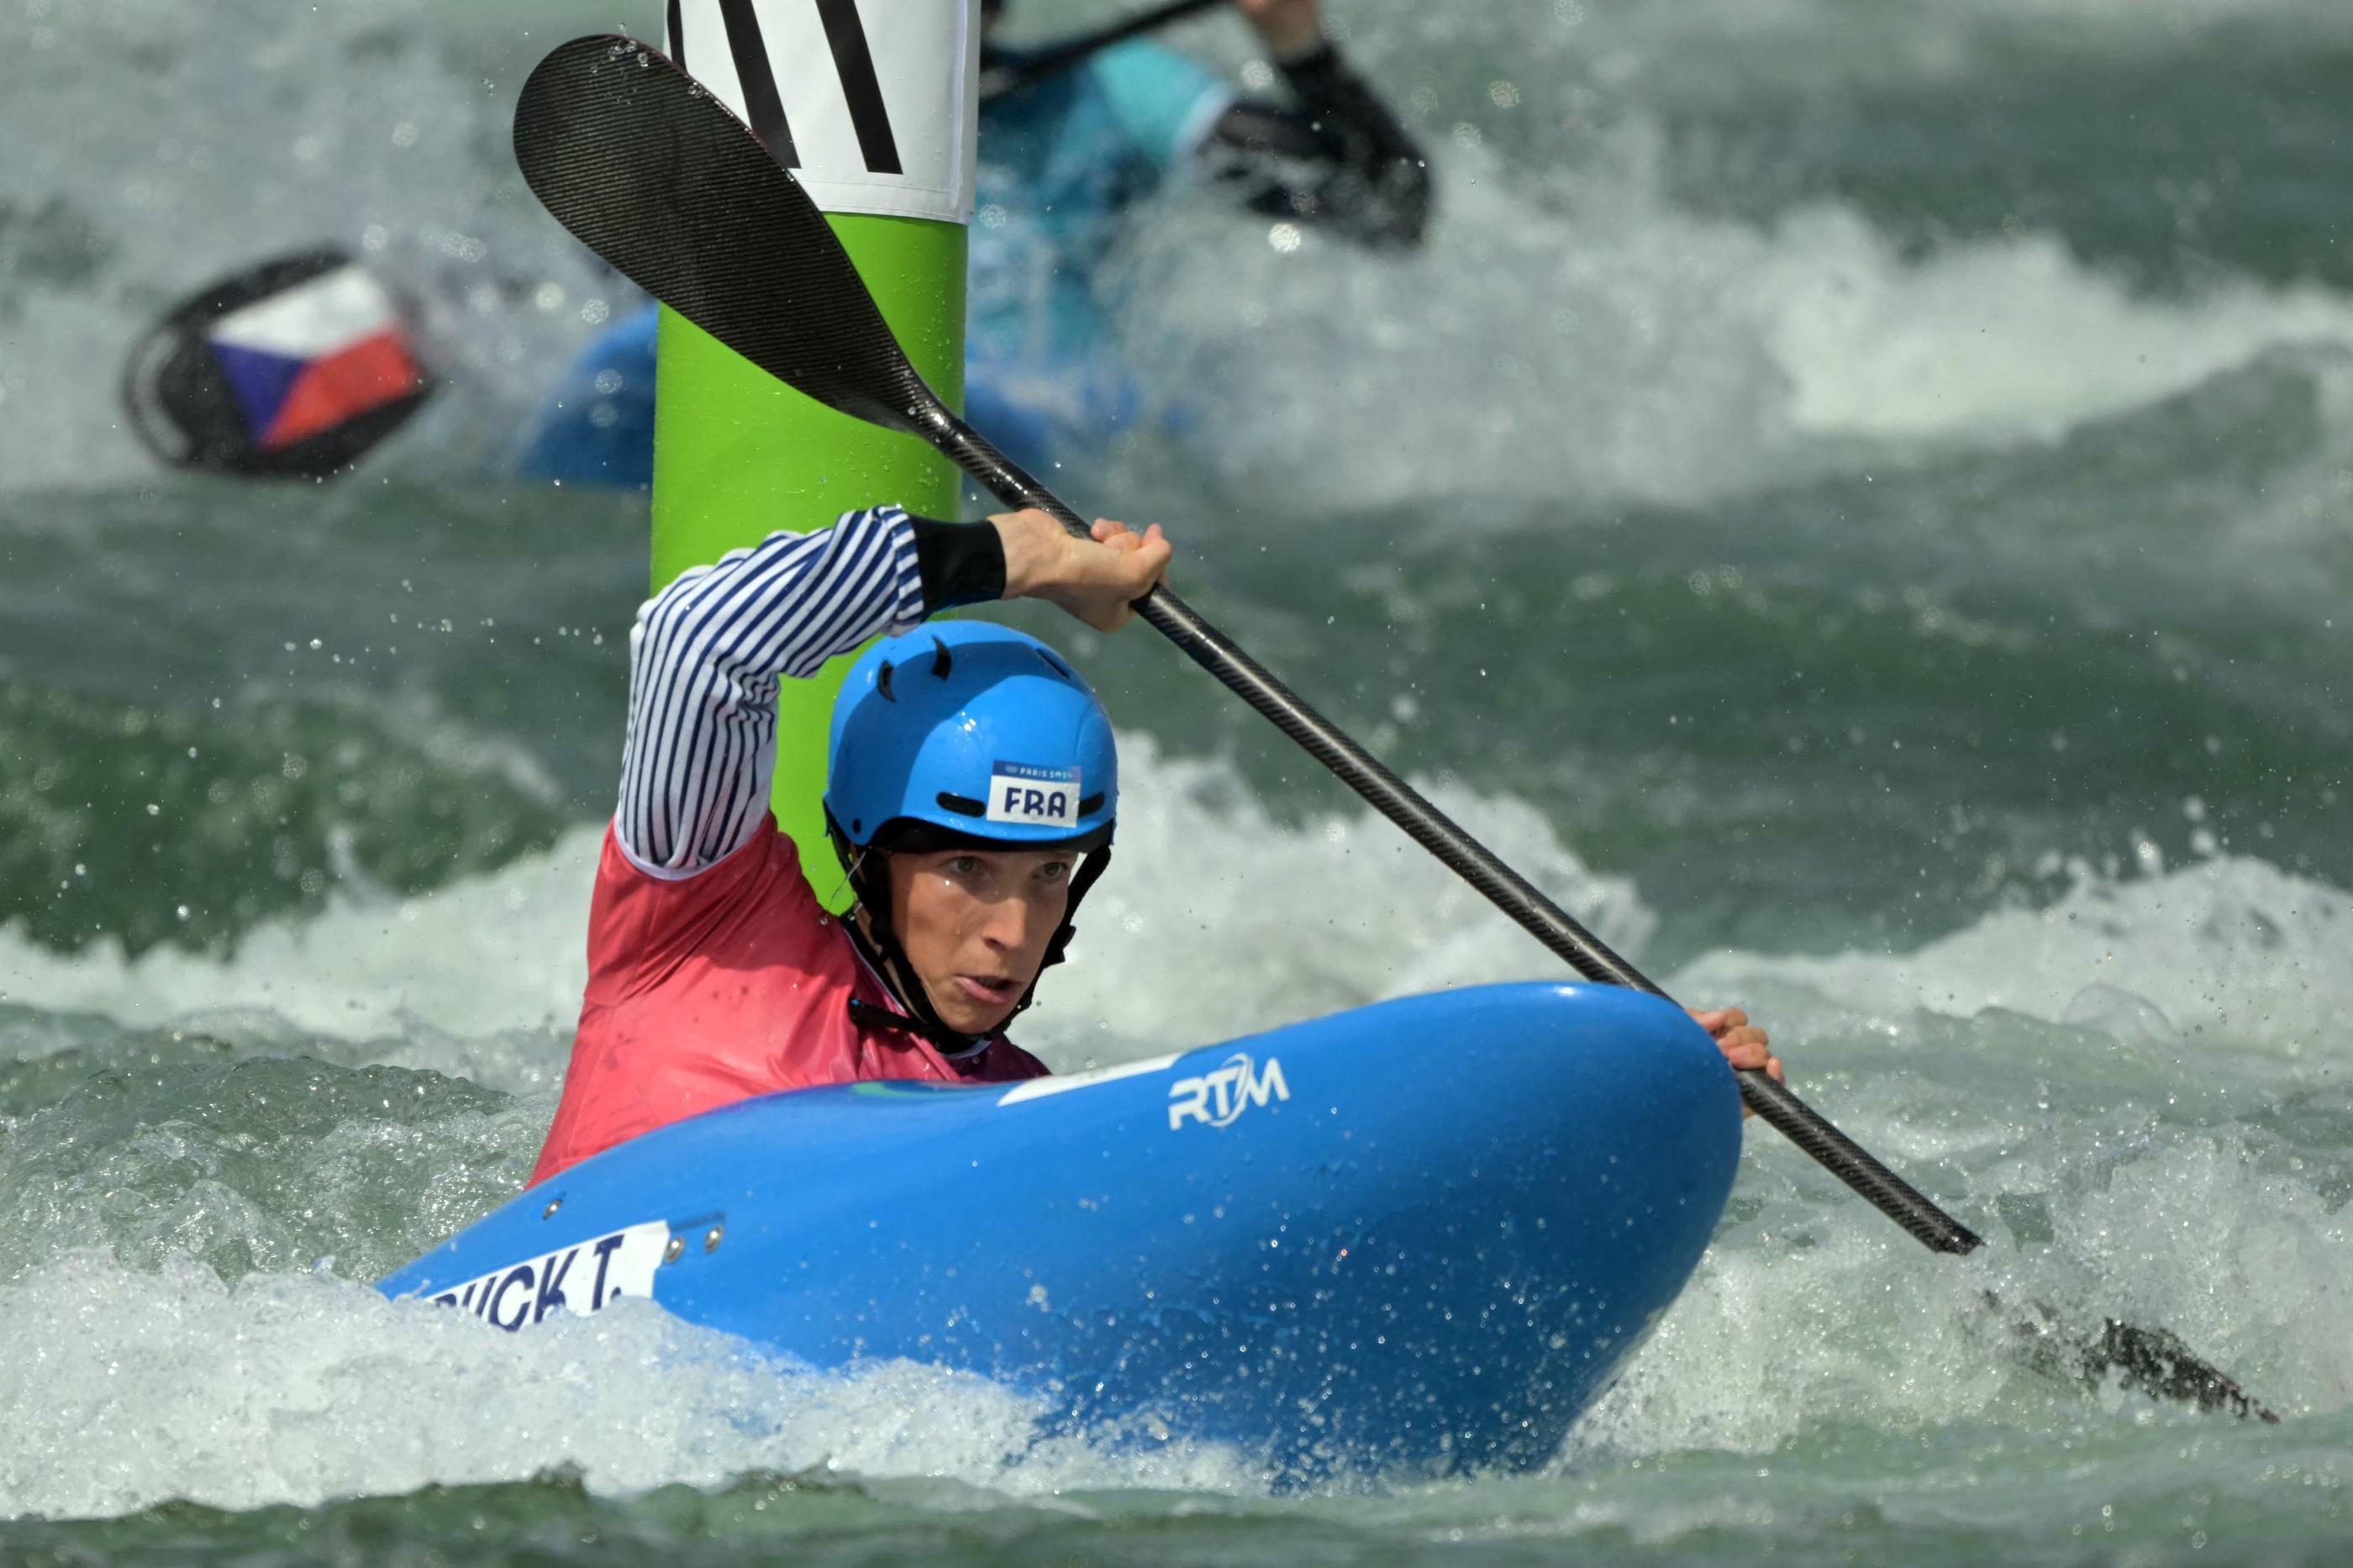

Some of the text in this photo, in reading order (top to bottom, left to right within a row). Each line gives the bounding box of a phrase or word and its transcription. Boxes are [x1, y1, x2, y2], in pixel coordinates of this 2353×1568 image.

[1019, 766, 1048, 778] PARIS
[1003, 786, 1067, 818] FRA
[1168, 1054, 1291, 1131] RTM
[592, 1234, 626, 1313] T.
